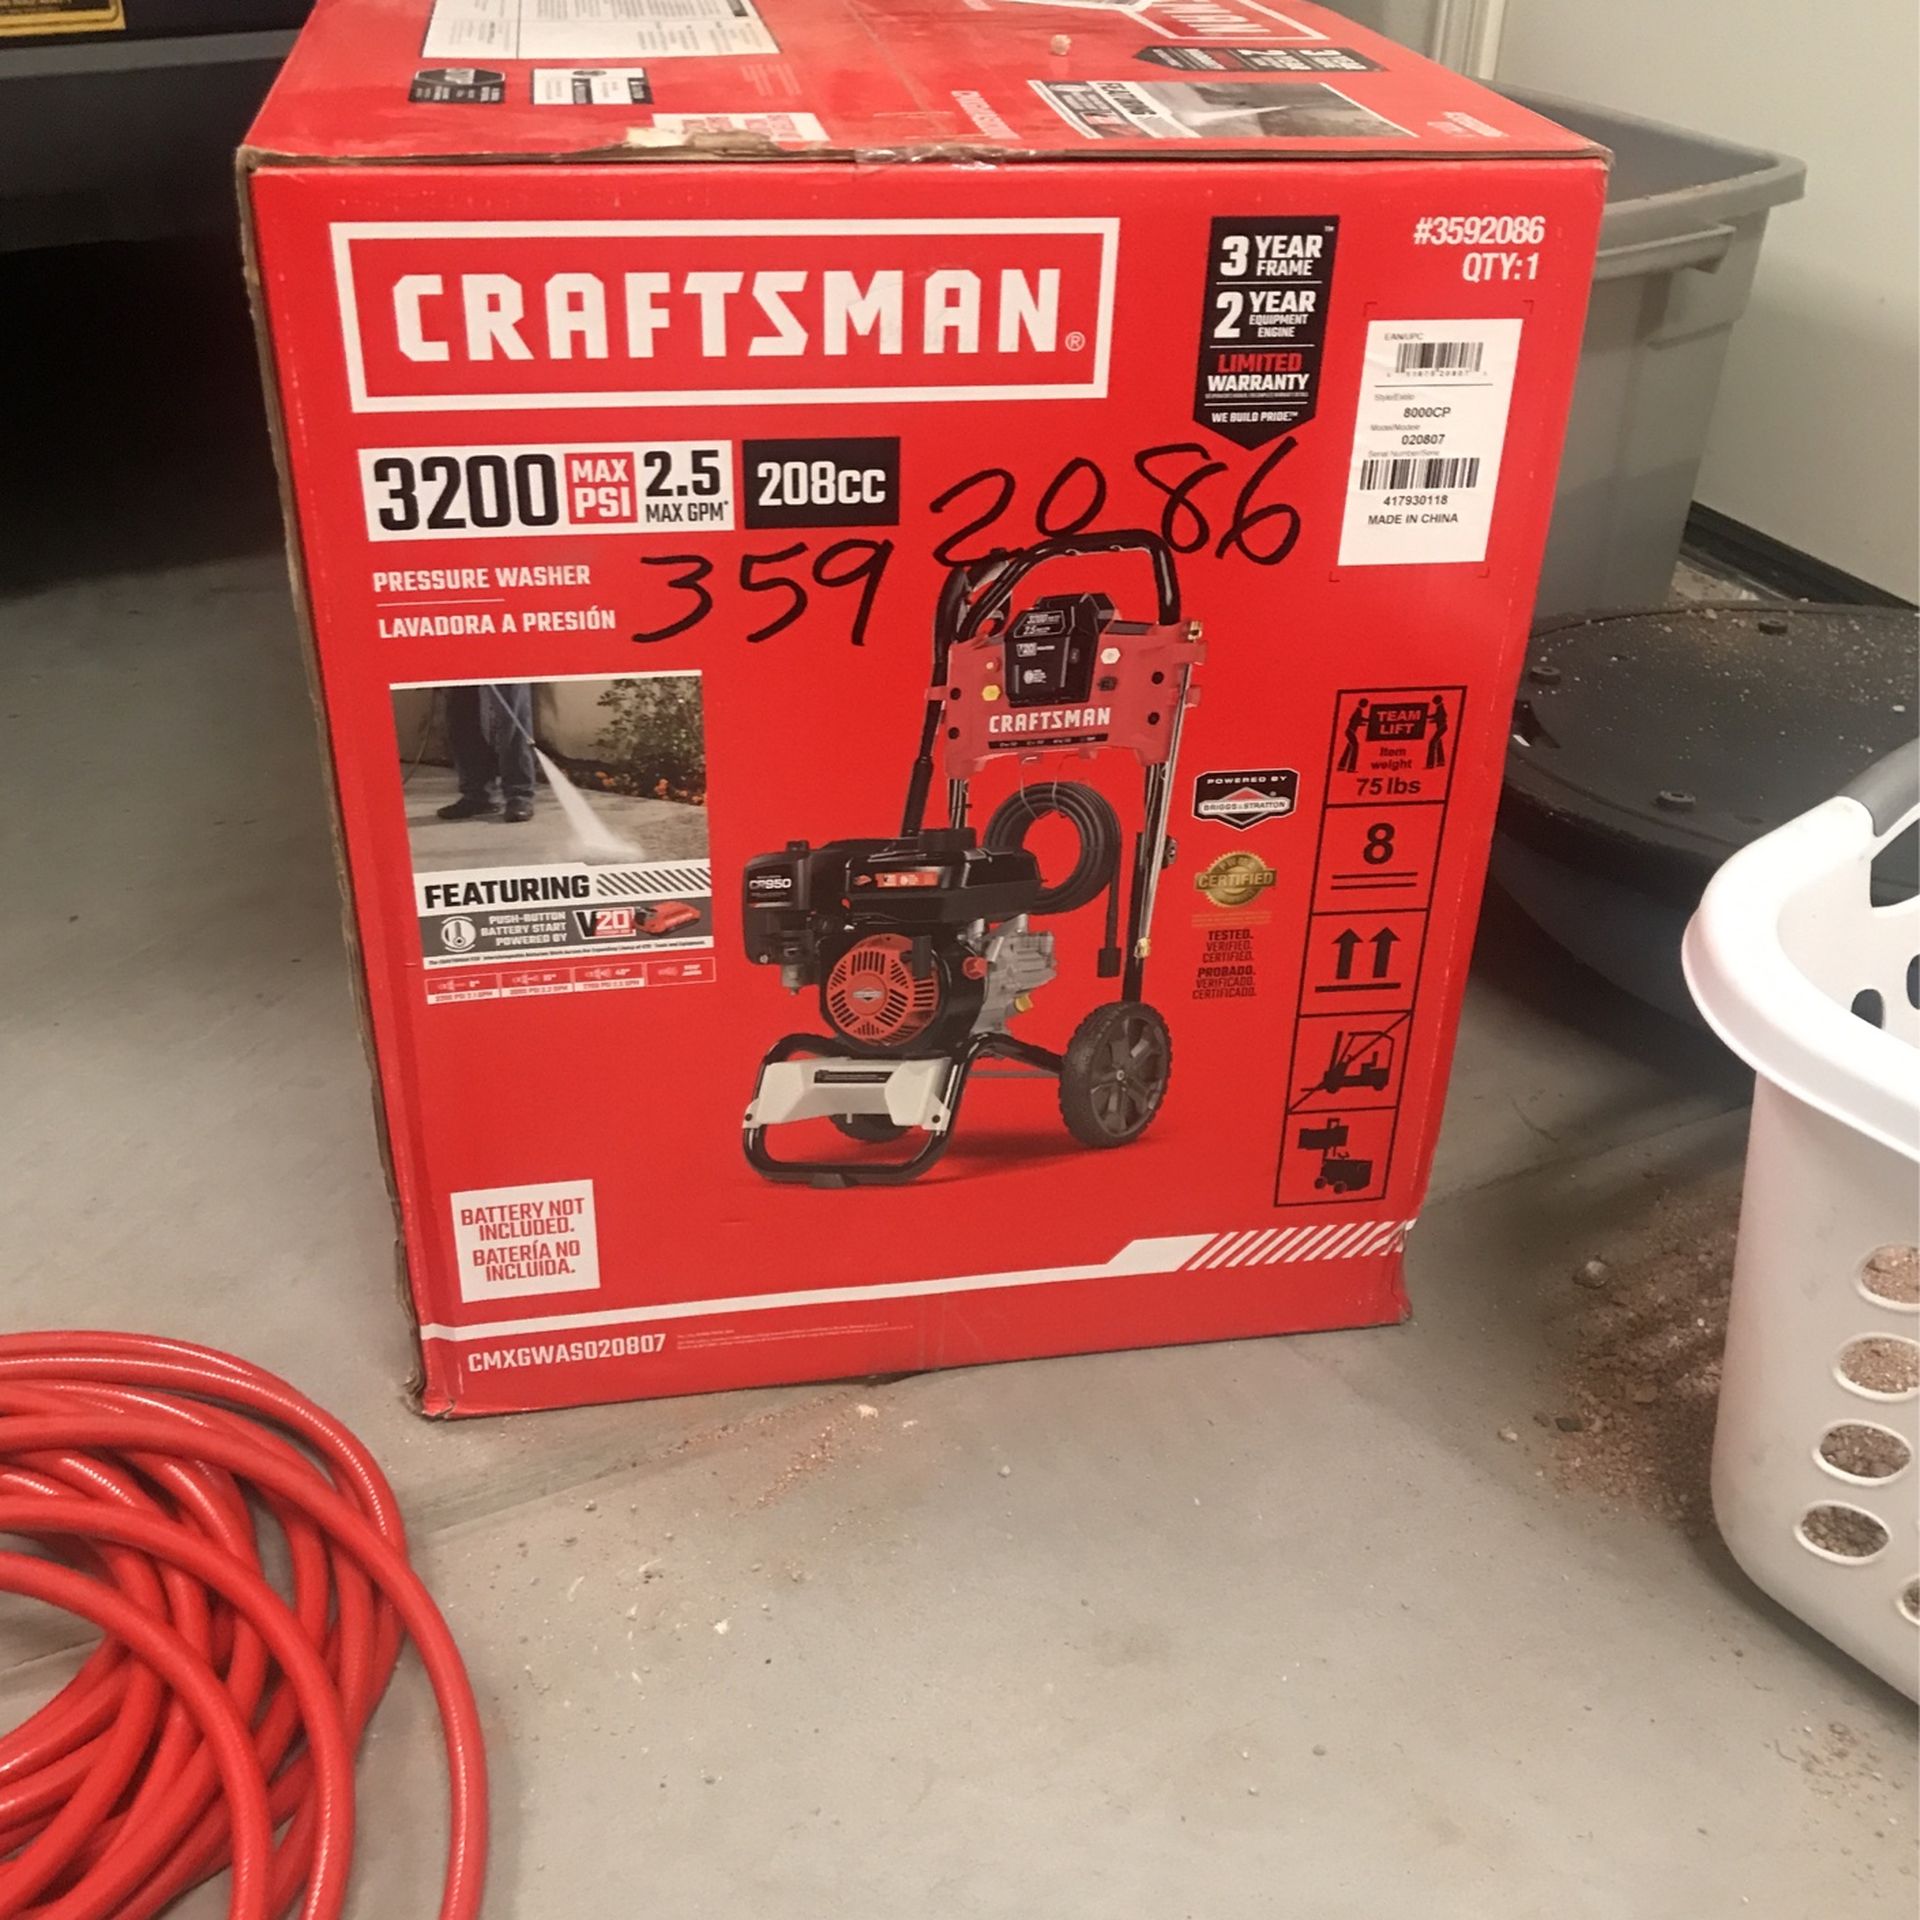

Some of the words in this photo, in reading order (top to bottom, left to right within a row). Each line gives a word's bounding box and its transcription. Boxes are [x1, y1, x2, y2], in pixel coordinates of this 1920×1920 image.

[1413, 215, 1546, 246] #3592086
[1220, 235, 1250, 277] 3
[1255, 234, 1324, 260] YEAR
[1256, 259, 1314, 277] FRAME
[1462, 252, 1541, 283] QTY:1
[1213, 291, 1244, 339] 2
[1249, 290, 1317, 313] YEAR
[1249, 313, 1309, 326] EQUIPMENT
[1257, 326, 1296, 338] ENGINE
[1217, 353, 1303, 373] LIMITED
[1207, 373, 1310, 392] WARRANTY
[1211, 411, 1229, 423] WE
[1229, 410, 1259, 423] BUILD
[1403, 406, 1452, 418] 8000CP
[1401, 433, 1446, 445] 020807
[571, 458, 628, 484] MAX
[645, 449, 721, 498] 2.5
[373, 453, 560, 531] 3200
[757, 460, 887, 508] 208cc
[574, 486, 632, 519] PSI
[1383, 494, 1449, 507] 417930118
[646, 502, 684, 523] MAX
[1368, 514, 1402, 525] MADE
[1406, 514, 1418, 524] IN
[1421, 513, 1459, 524] CHINA
[373, 568, 490, 593] PRESSURE
[494, 564, 591, 589] WASHER
[379, 613, 496, 640] LAVADORA
[501, 612, 518, 634] A
[522, 605, 617, 634] PRESIÓN
[989, 707, 1112, 733] CRAFTSMAN
[1376, 710, 1421, 722] TEAM
[1380, 722, 1415, 735] LIFT
[1379, 746, 1406, 757] Item
[1370, 759, 1412, 771] weight
[1207, 776, 1267, 785] POWERED
[1356, 777, 1384, 797] 75
[1387, 777, 1421, 796] lbs
[1363, 822, 1395, 865] 8
[1198, 872, 1275, 889] CERTIFIED
[424, 874, 590, 909] FEATURING
[489, 911, 566, 925] PUSH-BUTTON
[480, 923, 531, 937] BATTERY
[532, 922, 566, 933] START
[1208, 929, 1254, 941] TESTED.
[496, 934, 549, 947] POWERED
[552, 933, 567, 943] BY
[460, 1201, 544, 1226] BATTERY
[549, 1197, 585, 1215] NOT
[478, 1216, 575, 1241] INCLUDED.
[472, 1239, 552, 1267] BATERÍA
[555, 1239, 581, 1258] NO
[485, 1258, 577, 1282] INCLUIDA.
[468, 1333, 667, 1374] CMXGWAS020807
